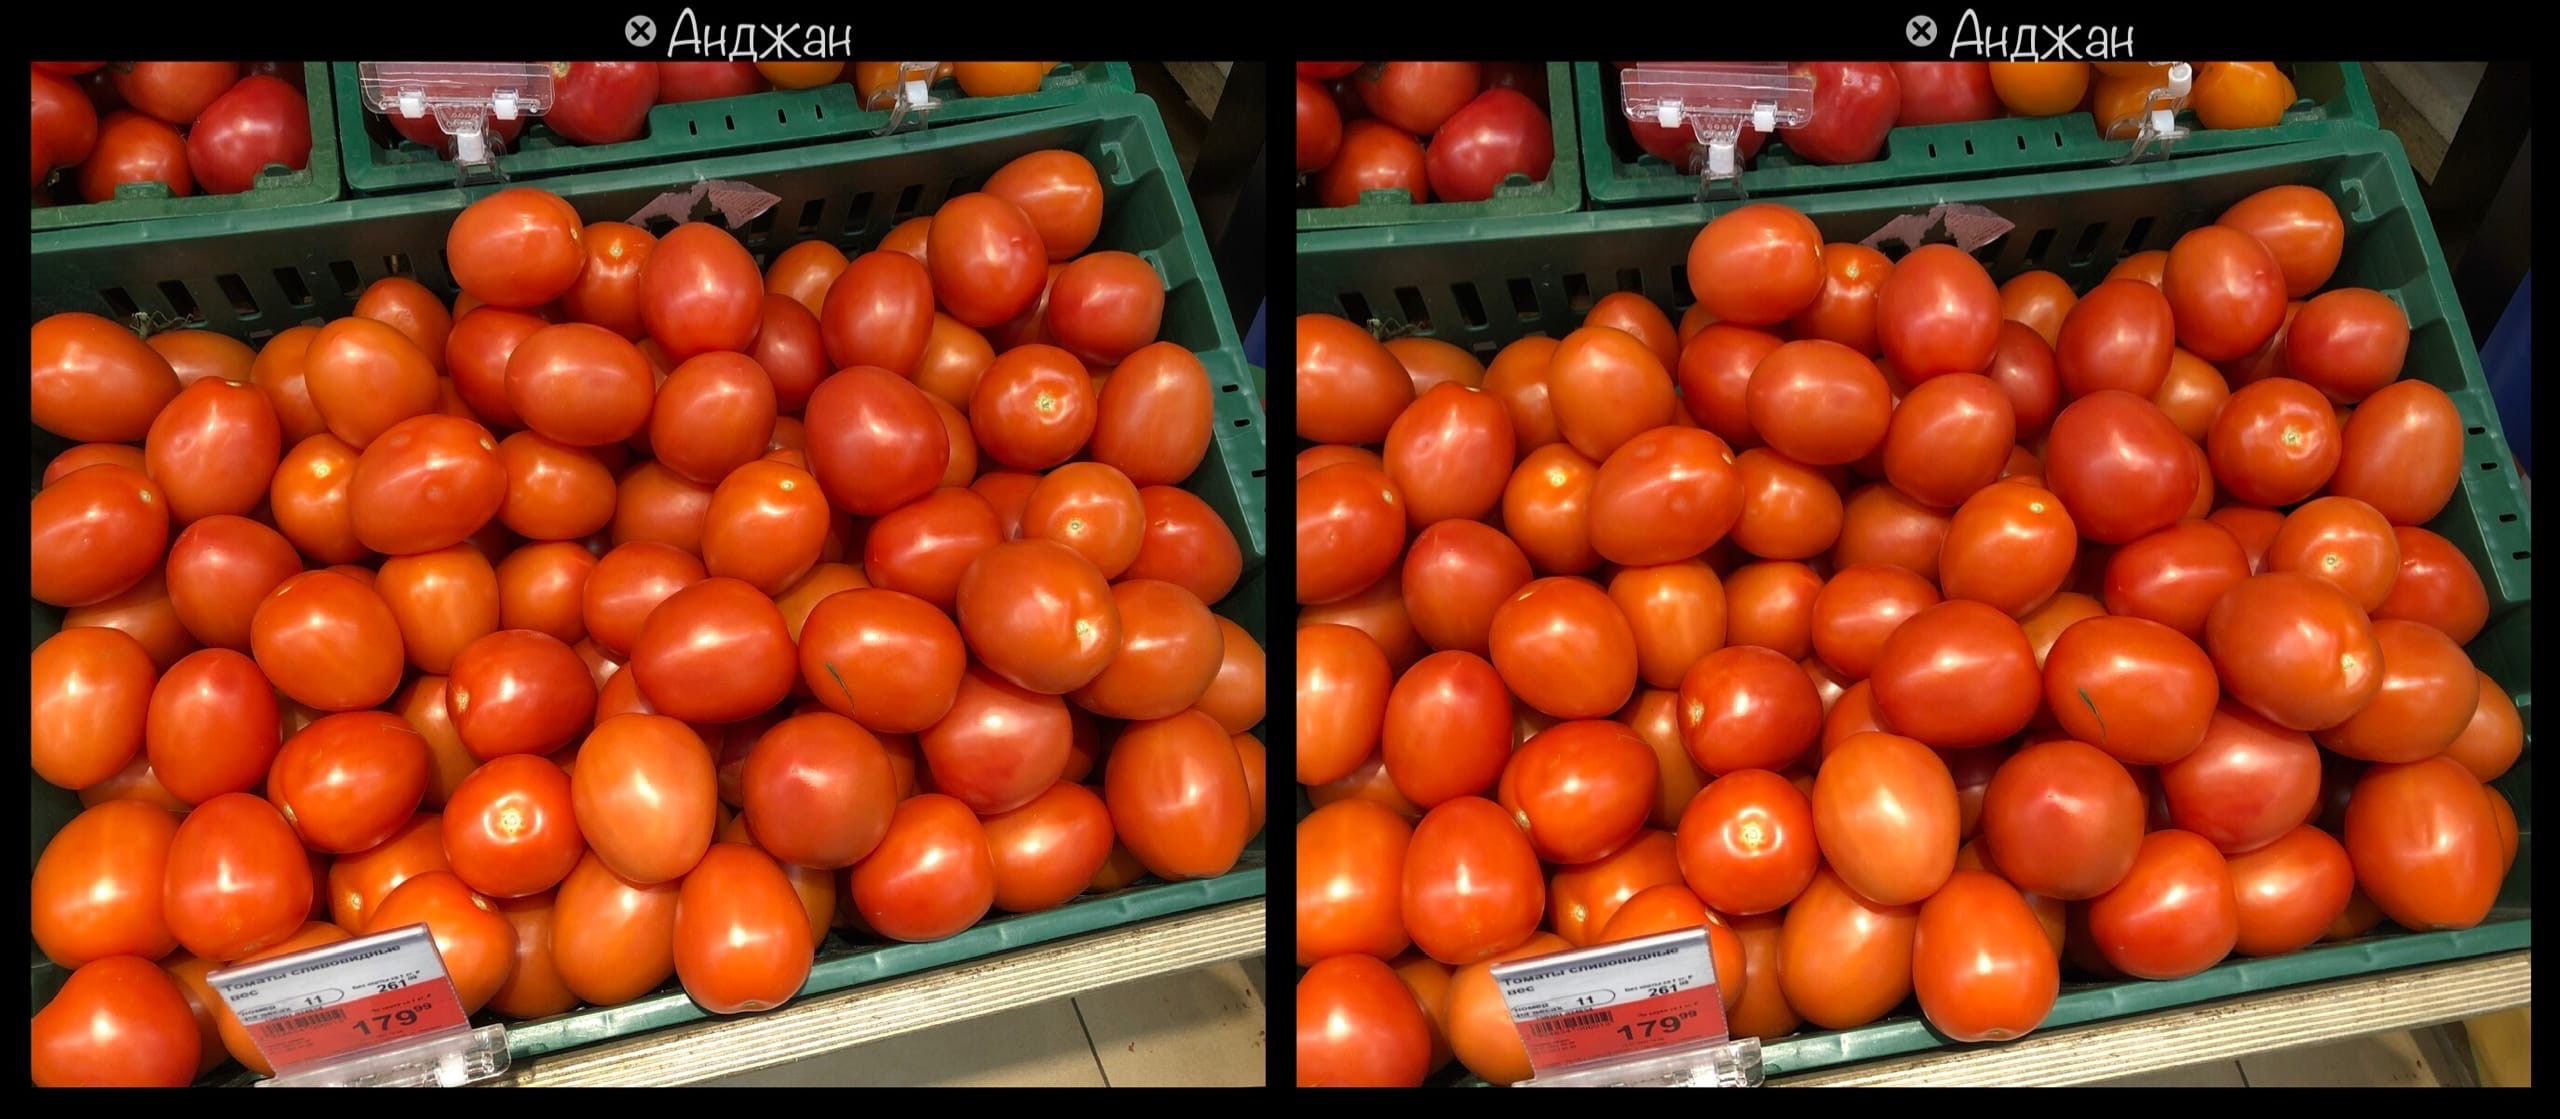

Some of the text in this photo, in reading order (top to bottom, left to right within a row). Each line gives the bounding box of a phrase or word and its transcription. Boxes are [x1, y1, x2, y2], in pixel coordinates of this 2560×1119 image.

[221, 945, 401, 992] Томаты сливовидные
[1501, 947, 1679, 987] Томаты сливовидные
[376, 979, 407, 993] 261
[1507, 985, 1535, 996] вес
[1648, 983, 1678, 998] 261
[229, 990, 259, 1002] вес
[304, 995, 323, 1006] 11
[1576, 995, 1594, 1006] 11
[352, 1008, 418, 1036] 179
[1616, 1015, 1681, 1041] 179
